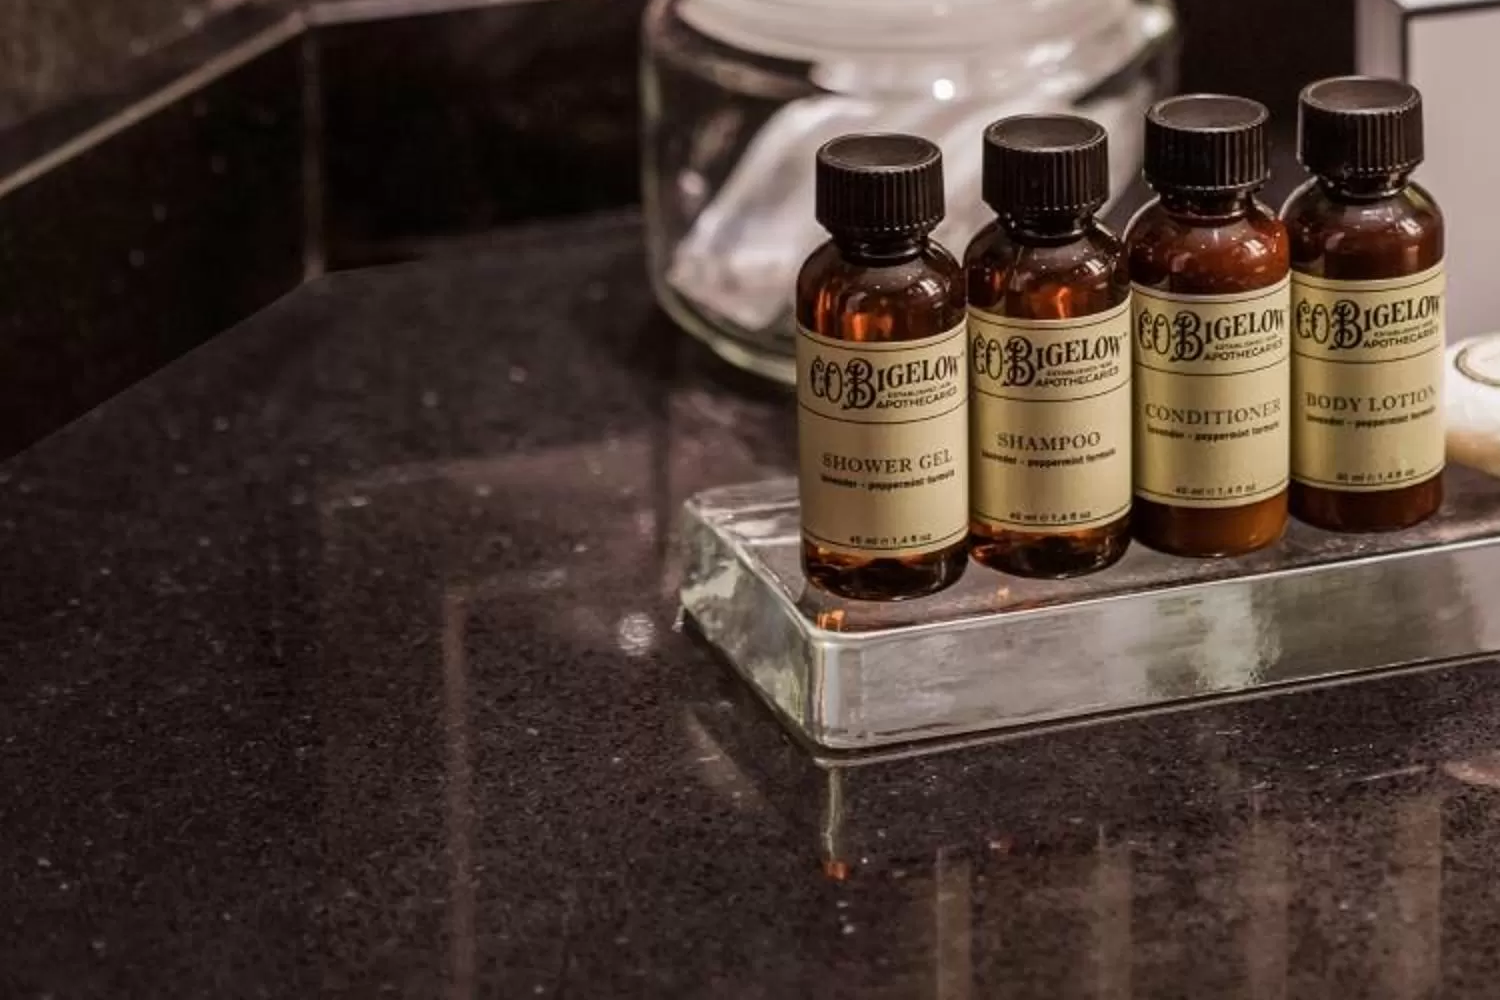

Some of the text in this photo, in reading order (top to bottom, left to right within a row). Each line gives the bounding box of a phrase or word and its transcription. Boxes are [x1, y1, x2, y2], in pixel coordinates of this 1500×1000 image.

[1145, 398, 1281, 425] CONDITIONER
[1305, 391, 1360, 413] BODY
[997, 431, 1101, 451] SHAMPOO
[822, 448, 952, 474] SHOWER GEL
